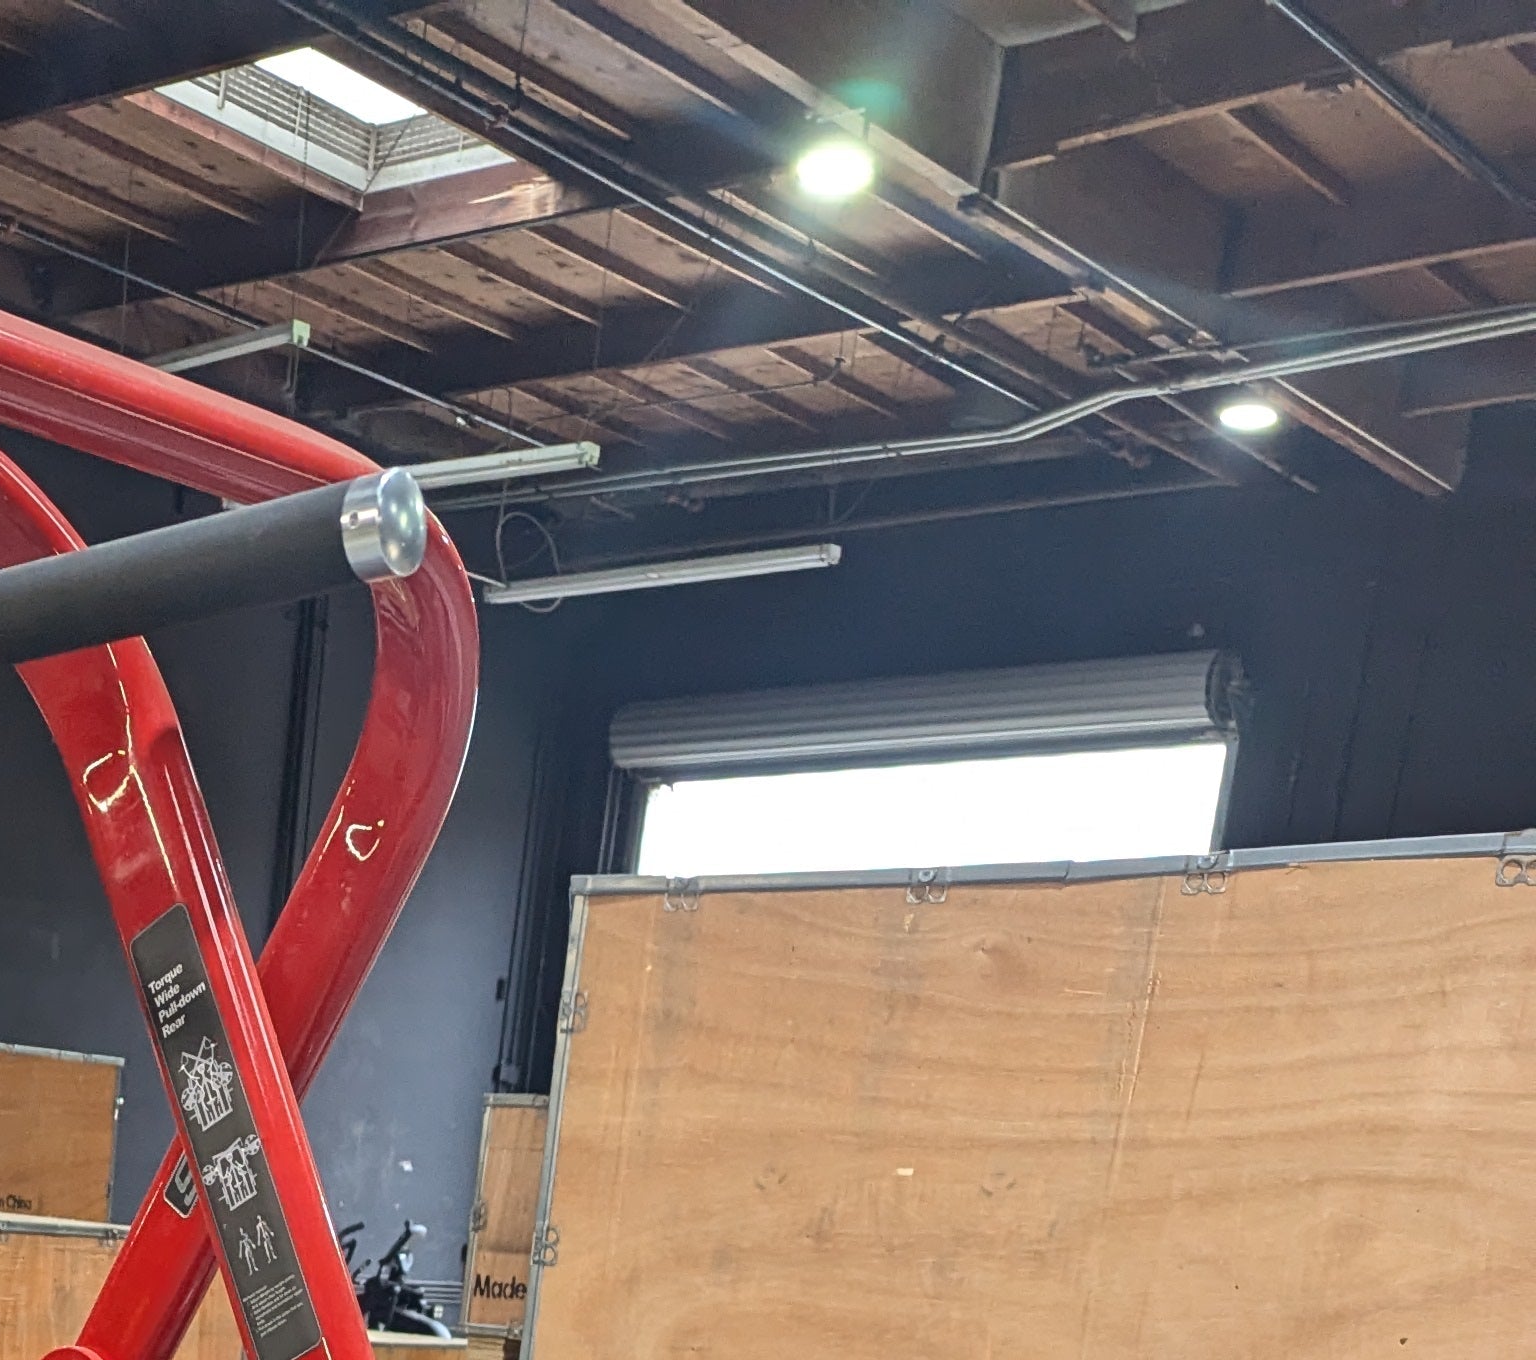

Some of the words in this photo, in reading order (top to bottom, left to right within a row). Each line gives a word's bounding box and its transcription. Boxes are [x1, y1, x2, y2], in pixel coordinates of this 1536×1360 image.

[148, 964, 183, 994] Torque
[154, 984, 180, 1008] Wide
[158, 981, 206, 1023] Pull-down
[161, 1014, 186, 1038] Rear
[6, 1194, 33, 1210] China
[473, 1273, 527, 1300] Made
